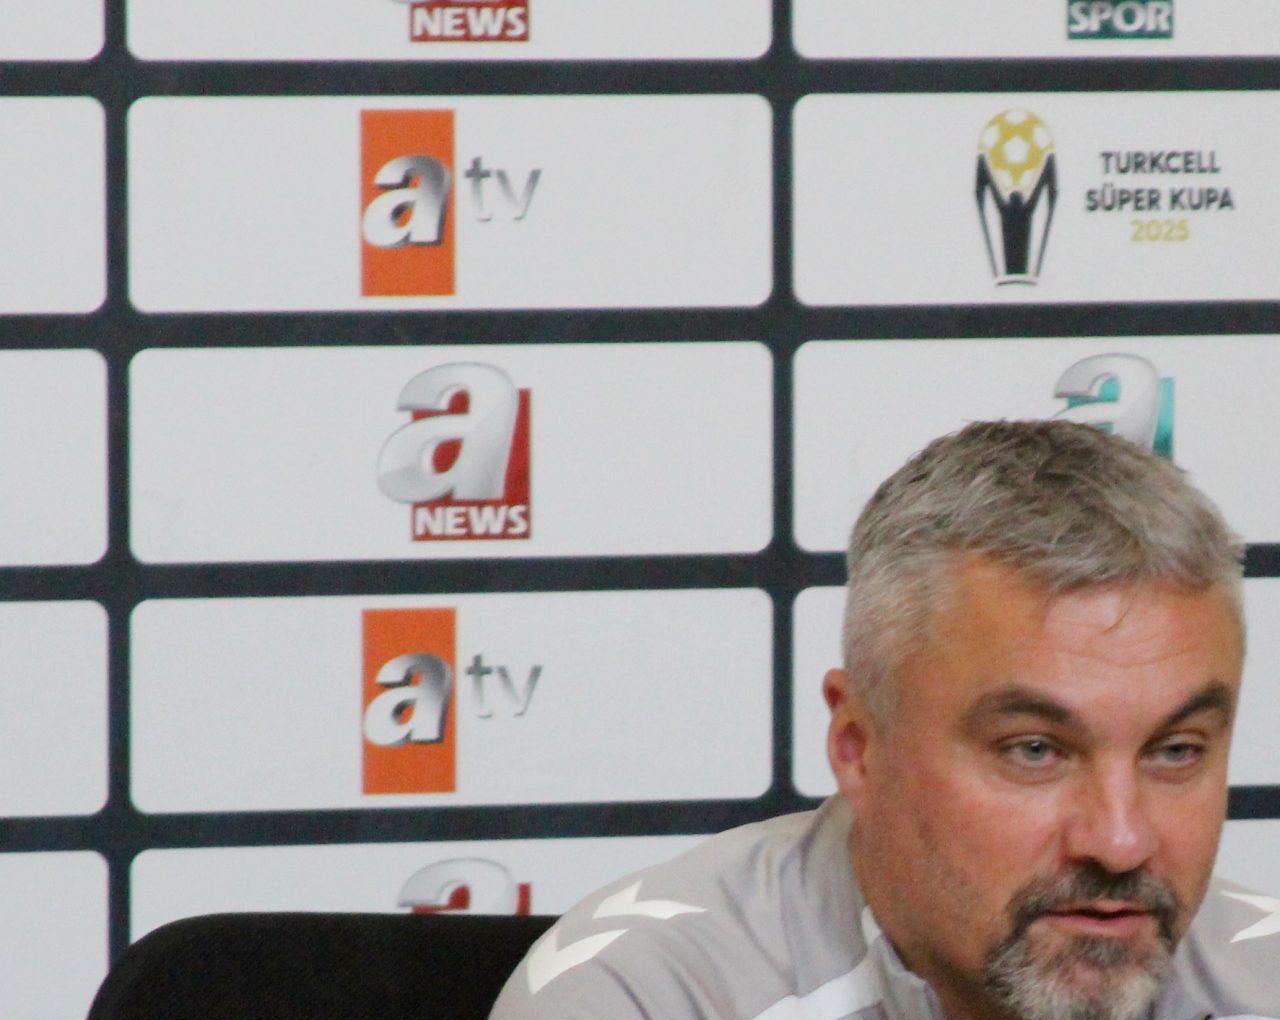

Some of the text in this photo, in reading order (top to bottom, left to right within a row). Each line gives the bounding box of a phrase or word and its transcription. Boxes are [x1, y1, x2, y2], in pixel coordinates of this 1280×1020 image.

[413, 6, 527, 37] NEWS
[1070, 1, 1171, 33] SPOR
[1101, 151, 1221, 174] TURKCELL
[362, 154, 542, 248] atv
[1086, 181, 1235, 211] SÜPER KUPA
[1131, 219, 1190, 242] 2025
[415, 505, 529, 536] NEWS
[364, 652, 543, 748] atv
